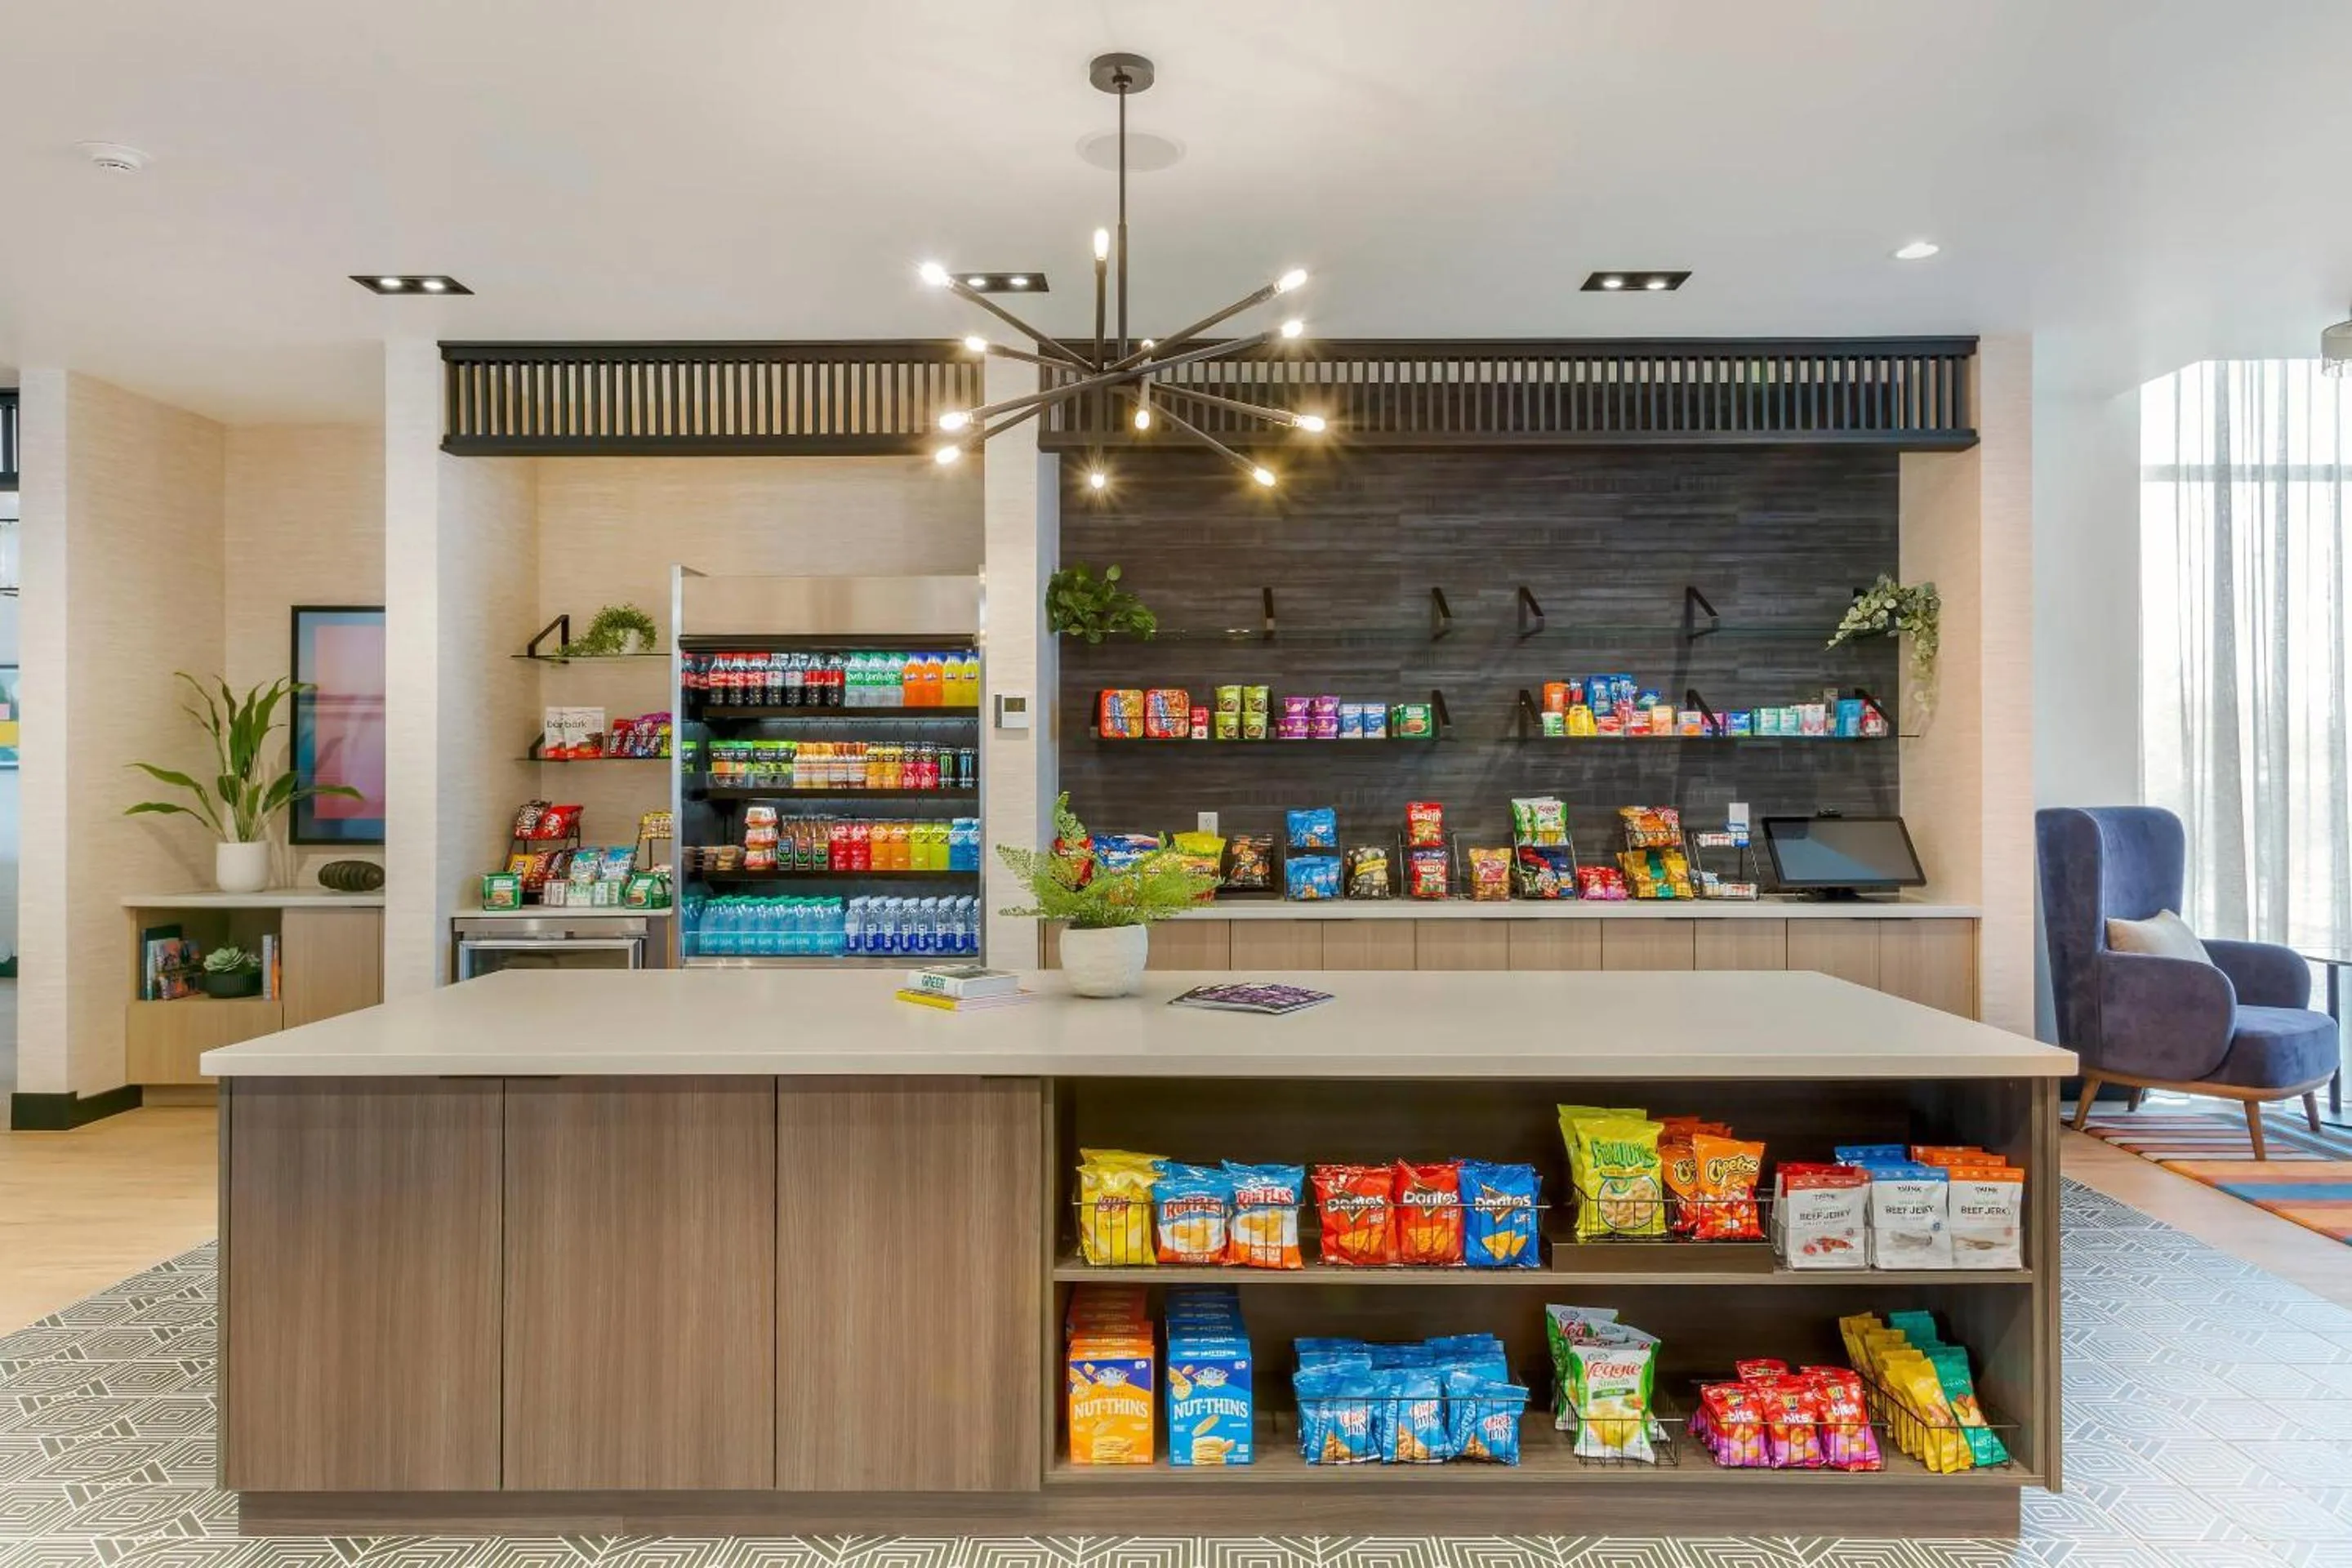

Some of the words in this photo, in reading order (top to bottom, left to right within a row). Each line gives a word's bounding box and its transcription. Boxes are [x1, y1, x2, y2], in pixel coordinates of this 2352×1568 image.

[1705, 1155, 1758, 1184] Cheetos
[1326, 1194, 1385, 1213] Doritos
[1402, 1190, 1458, 1205] Doritos
[1474, 1193, 1531, 1212] Doritos
[1886, 1205, 1907, 1214] BEEF
[1961, 1205, 1982, 1214] BEEF
[1585, 1360, 1642, 1381] Veggie
[1074, 1397, 1148, 1419] NUT-THINS
[1174, 1397, 1249, 1419] NUT-THINS
